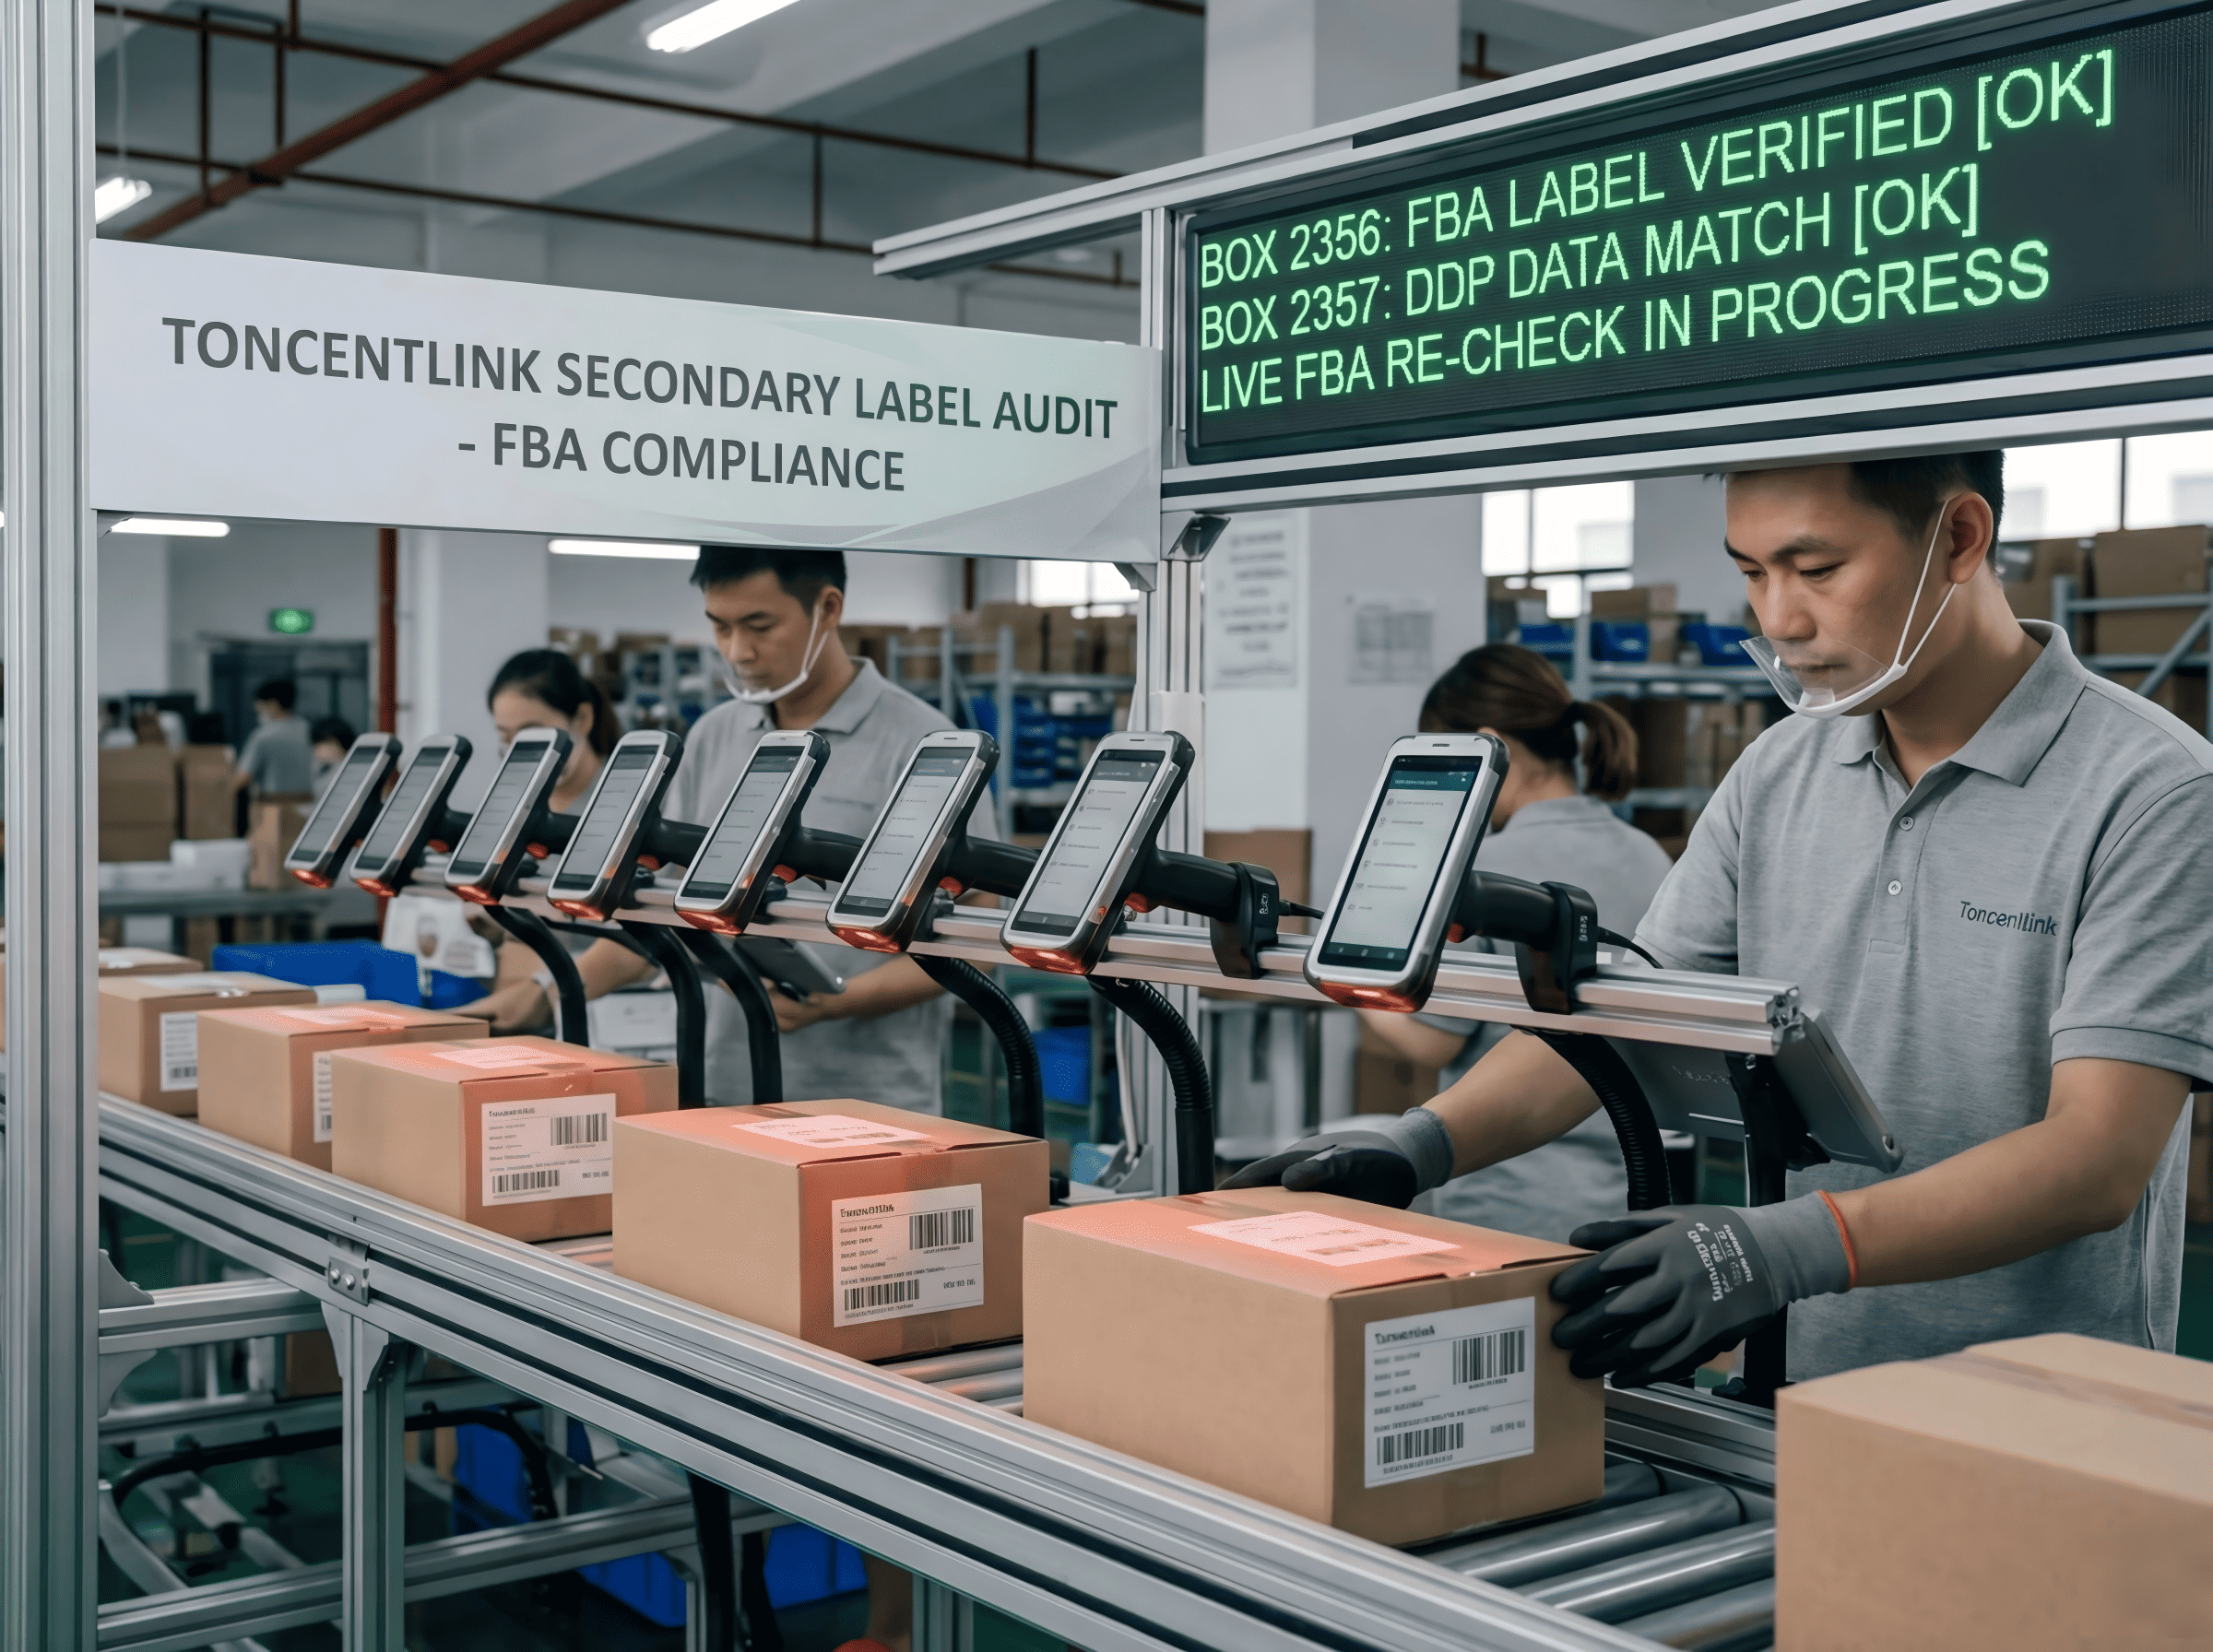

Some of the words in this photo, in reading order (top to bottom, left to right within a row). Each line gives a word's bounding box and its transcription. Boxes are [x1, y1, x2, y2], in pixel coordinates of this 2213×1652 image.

[1201, 229, 1279, 289] BOX
[1290, 208, 1391, 271] 2356:
[1408, 185, 1494, 248] FBA
[1509, 151, 1665, 228] LABEL
[1680, 87, 1953, 192] VERIFIED
[1977, 49, 2112, 152] [OK]
[1201, 294, 1279, 351] BOX
[1290, 275, 1391, 336] 2357:
[1406, 254, 1496, 316] DDP
[1509, 231, 1630, 299] DATA
[1645, 192, 1830, 277] MATCH
[1854, 162, 1978, 256] [OK]
[1201, 357, 1283, 413] LIVE
[1296, 345, 1376, 400] FBA
[1387, 305, 1627, 388] RE-CHECK
[1644, 294, 1691, 352] IN
[1711, 240, 2050, 343] PROGRESS
[161, 317, 542, 394] TONCENTLINK
[557, 352, 841, 416] SECONDARY
[855, 378, 981, 429] LABEL
[992, 391, 1118, 439] AUDIT
[458, 442, 476, 452] -
[494, 422, 587, 472] FBA
[603, 431, 905, 491] COMPLIANCE
